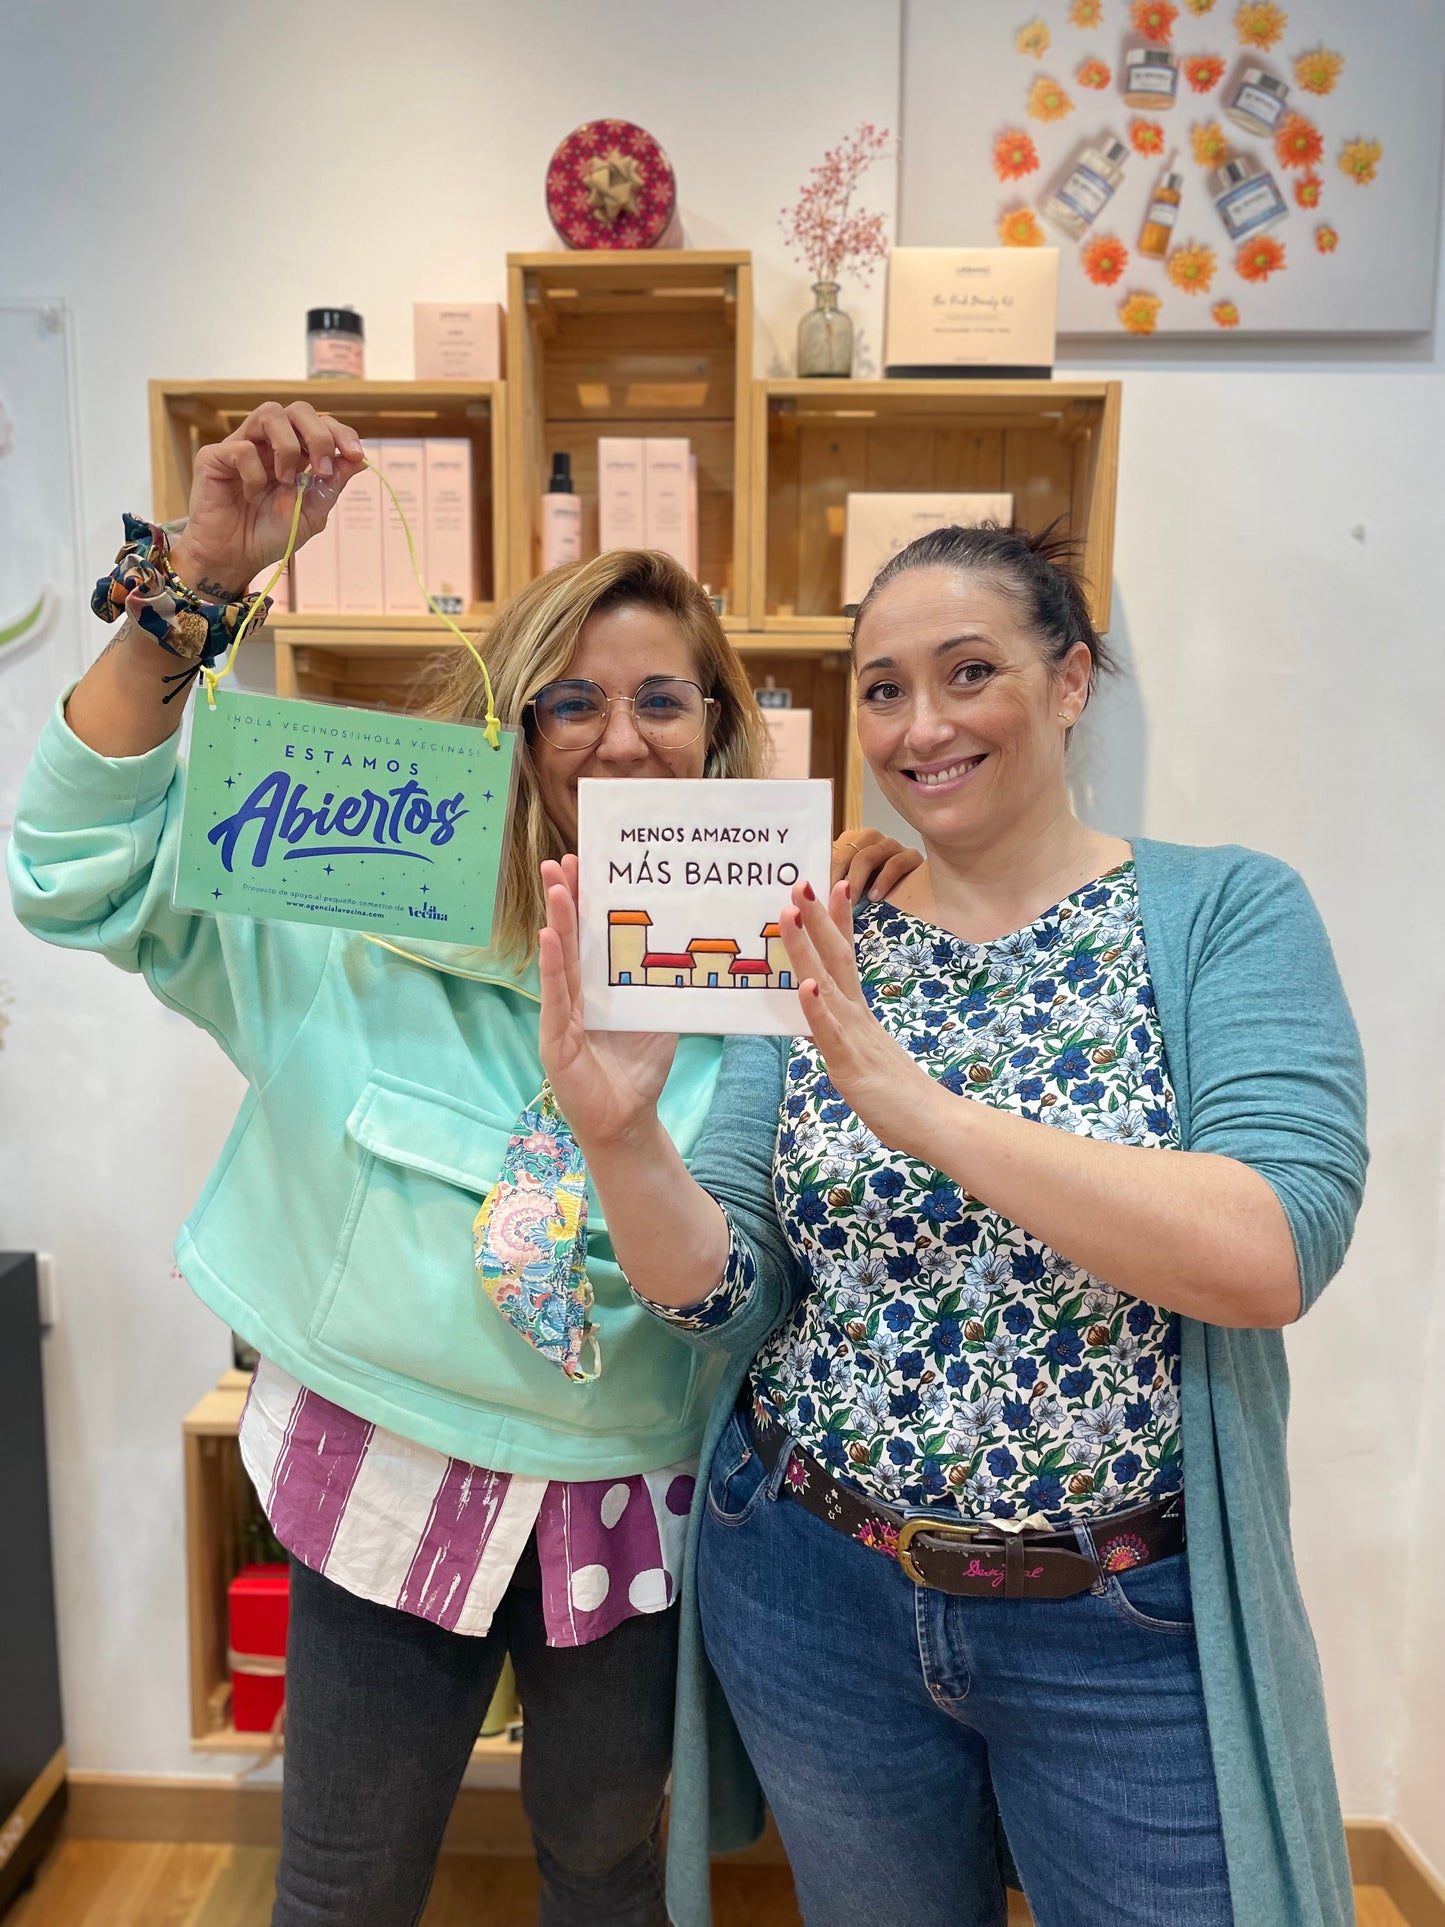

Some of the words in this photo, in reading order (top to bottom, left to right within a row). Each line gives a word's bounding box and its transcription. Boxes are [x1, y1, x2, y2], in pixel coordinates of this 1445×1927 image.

[285, 744, 419, 776] ESTAMOS
[411, 740, 480, 757] VECINAS!
[207, 770, 470, 873] Abiertos
[621, 827, 685, 843] MENOS
[691, 827, 770, 843] AMAZON
[777, 828, 789, 844] Y
[609, 849, 672, 885] MÁS
[685, 861, 799, 887] BARRIO
[242, 883, 277, 895] Proyecto
[279, 888, 289, 896] de
[290, 892, 313, 900] apoyo
[324, 895, 358, 906] pequeño
[359, 901, 393, 910] comercio
[395, 904, 405, 912] de
[286, 900, 385, 919] www.agencialavecina.com
